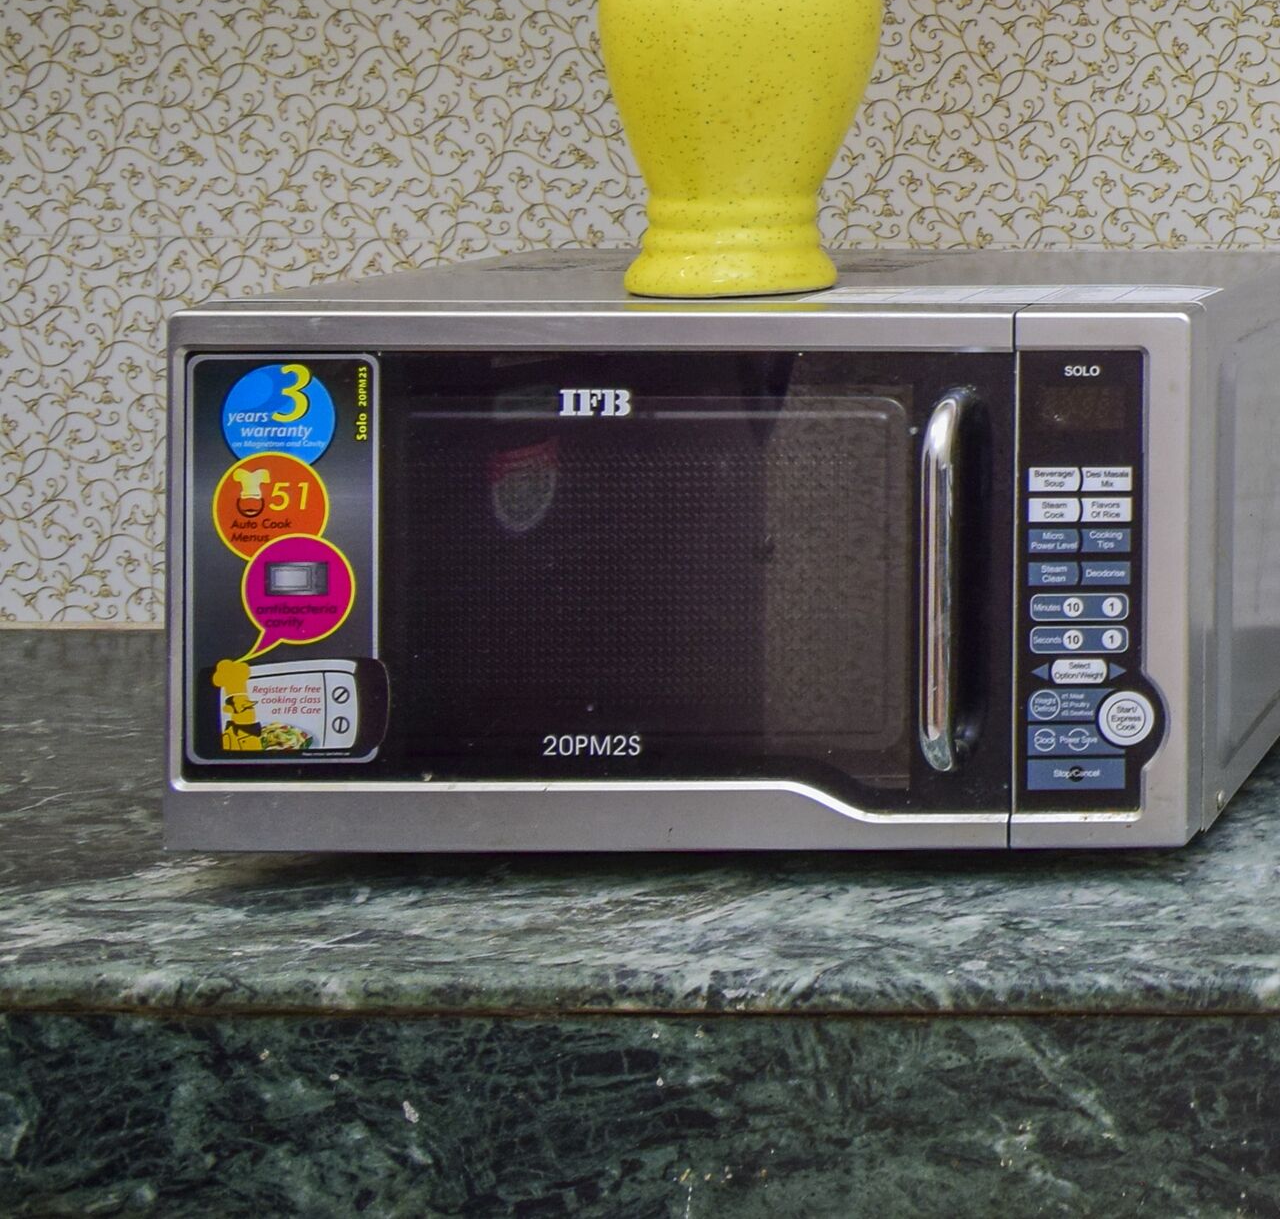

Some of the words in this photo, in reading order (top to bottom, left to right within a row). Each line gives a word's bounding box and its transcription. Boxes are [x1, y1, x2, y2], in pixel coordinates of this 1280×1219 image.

[1064, 365, 1101, 377] SOLO
[358, 366, 368, 407] 20PM2S
[271, 363, 310, 423] 3
[559, 389, 632, 417] IFB
[227, 411, 269, 427] years
[356, 413, 368, 441] Solo
[241, 424, 313, 441] warranty
[1034, 469, 1076, 479] Beverage/
[1043, 479, 1065, 489] Soup
[268, 482, 309, 511] 51
[1041, 501, 1067, 509] Steam
[1091, 501, 1121, 509] Flavors
[1043, 511, 1065, 519] Cook
[1090, 511, 1101, 519] Of
[1102, 511, 1121, 519] Rice
[230, 518, 258, 530] Auto
[262, 518, 292, 529] Cook
[230, 532, 271, 543] Menus
[1042, 532, 1064, 540] Micro
[1089, 530, 1123, 541] Cooking
[1031, 541, 1055, 550] Power
[1056, 541, 1078, 550] Level
[1097, 540, 1115, 550] Tips
[1041, 565, 1068, 574] Steam
[1085, 569, 1126, 578] Deodorise
[1041, 574, 1067, 583] Clean
[255, 602, 338, 615] antibacteria
[1033, 603, 1061, 612] Minutes
[1066, 602, 1081, 613] 10
[1108, 602, 1115, 613] 1
[265, 615, 305, 630] cavity
[1033, 635, 1062, 645] Seconds
[1066, 634, 1081, 645] 10
[1108, 634, 1115, 645] 1
[1068, 661, 1091, 670] Select
[252, 684, 287, 696] Register
[289, 684, 302, 694] for
[303, 684, 322, 694] free
[261, 695, 297, 707] cooking
[300, 695, 322, 705] class
[271, 707, 281, 715] at
[283, 706, 298, 715] IFB
[300, 706, 322, 715] Care
[1116, 706, 1138, 714] Start/
[1111, 715, 1142, 724] Express
[1116, 723, 1136, 731] Cook
[1034, 736, 1056, 744] Clock
[1059, 736, 1080, 744] Power
[542, 735, 642, 757] 20PM2S
[1053, 769, 1100, 779] Stop/Cancel
